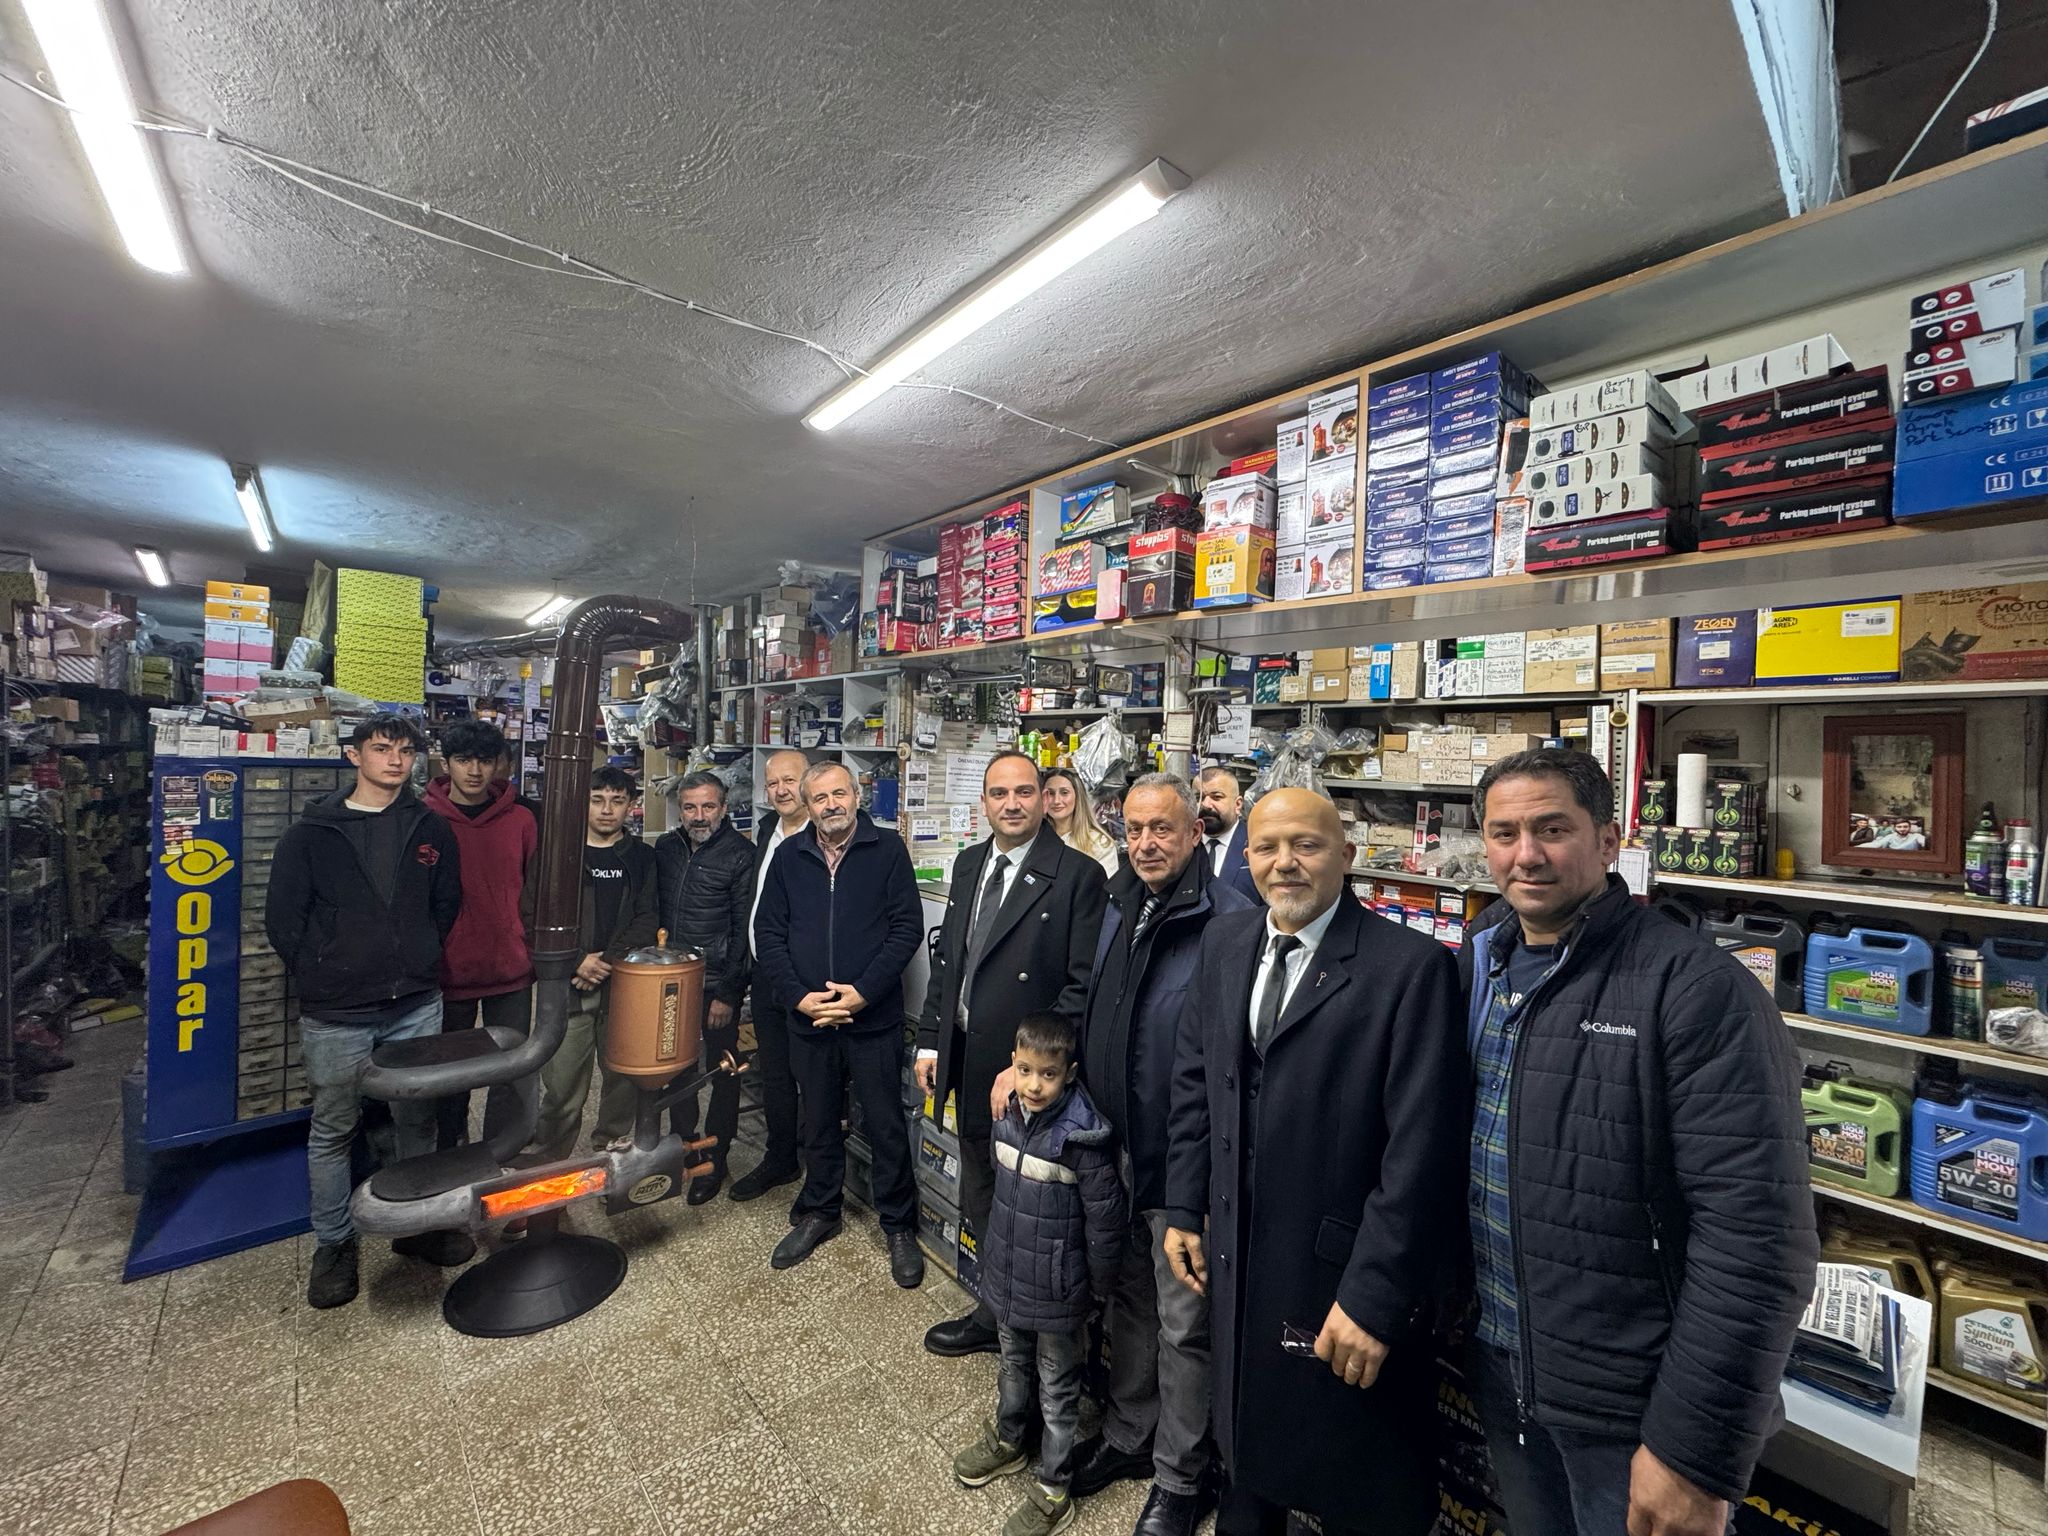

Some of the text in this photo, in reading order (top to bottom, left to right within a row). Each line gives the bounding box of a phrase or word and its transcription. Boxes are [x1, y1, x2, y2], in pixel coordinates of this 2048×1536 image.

[1780, 389, 1878, 419] Parking assistant system
[1989, 395, 2011, 408] CE
[1785, 454, 1815, 468] Parking
[1815, 448, 1852, 464] assistant
[1852, 444, 1883, 456] system
[1985, 453, 2007, 466] CE
[1780, 508, 1809, 520] Parking
[1809, 502, 1845, 516] assistant
[1845, 499, 1876, 510] system
[1587, 538, 1609, 547] Parking
[1610, 533, 1636, 544] assistant
[1637, 530, 1659, 540] system
[1994, 600, 2048, 614] MOTO
[1994, 610, 2048, 623] POWE
[592, 868, 623, 878] OKLYN
[1750, 952, 1772, 961] LIQUI
[1750, 958, 1772, 967] MOLY
[1869, 977, 1896, 986] MOLY
[1870, 970, 1895, 980] LIQUI
[1591, 1022, 1637, 1037] Columbia
[1841, 1124, 1864, 1135] LIQUI
[1841, 1130, 1865, 1142] MOLY
[1976, 1150, 2015, 1166] LIQUI
[1976, 1159, 2015, 1175] MOLY
[1939, 1166, 2016, 1199] 5W-30
[1964, 1318, 2015, 1339] PETRONAS
[1963, 1324, 2015, 1349] Syntium
[1963, 1335, 1993, 1350] 5000
